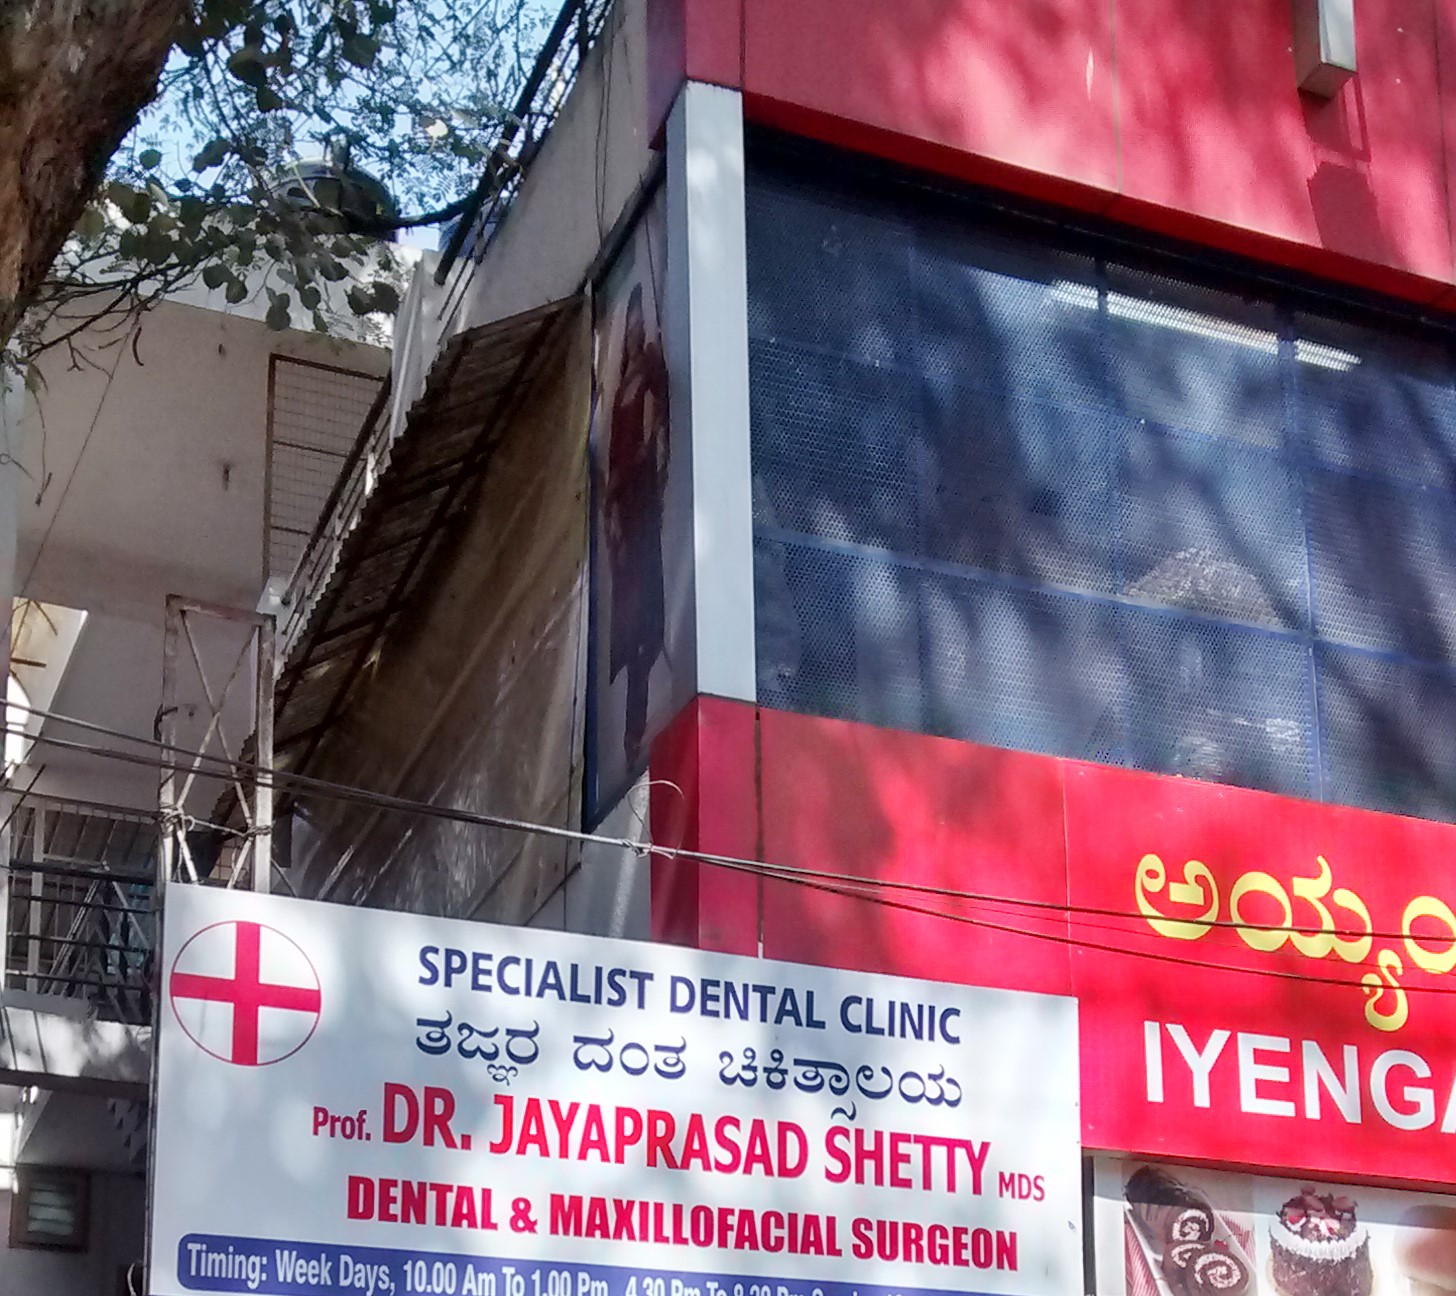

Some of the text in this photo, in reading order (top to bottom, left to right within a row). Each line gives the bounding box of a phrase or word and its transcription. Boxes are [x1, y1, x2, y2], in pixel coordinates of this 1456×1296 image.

[419, 946, 960, 1043] SPECIALIST DENTAL CLINIC
[573, 1029, 686, 1079] ದಂತ
[1145, 1022, 1456, 1132] IYENG
[313, 1084, 1044, 1200] Prof. DR. JAYAPRASAD SHETTY MDS
[188, 1244, 267, 1289] Timing:
[276, 1250, 332, 1285] Week
[404, 1261, 456, 1294] 10.00
[348, 1176, 1017, 1271] DENTAL & MAXILLOFACIAL SURGEON
